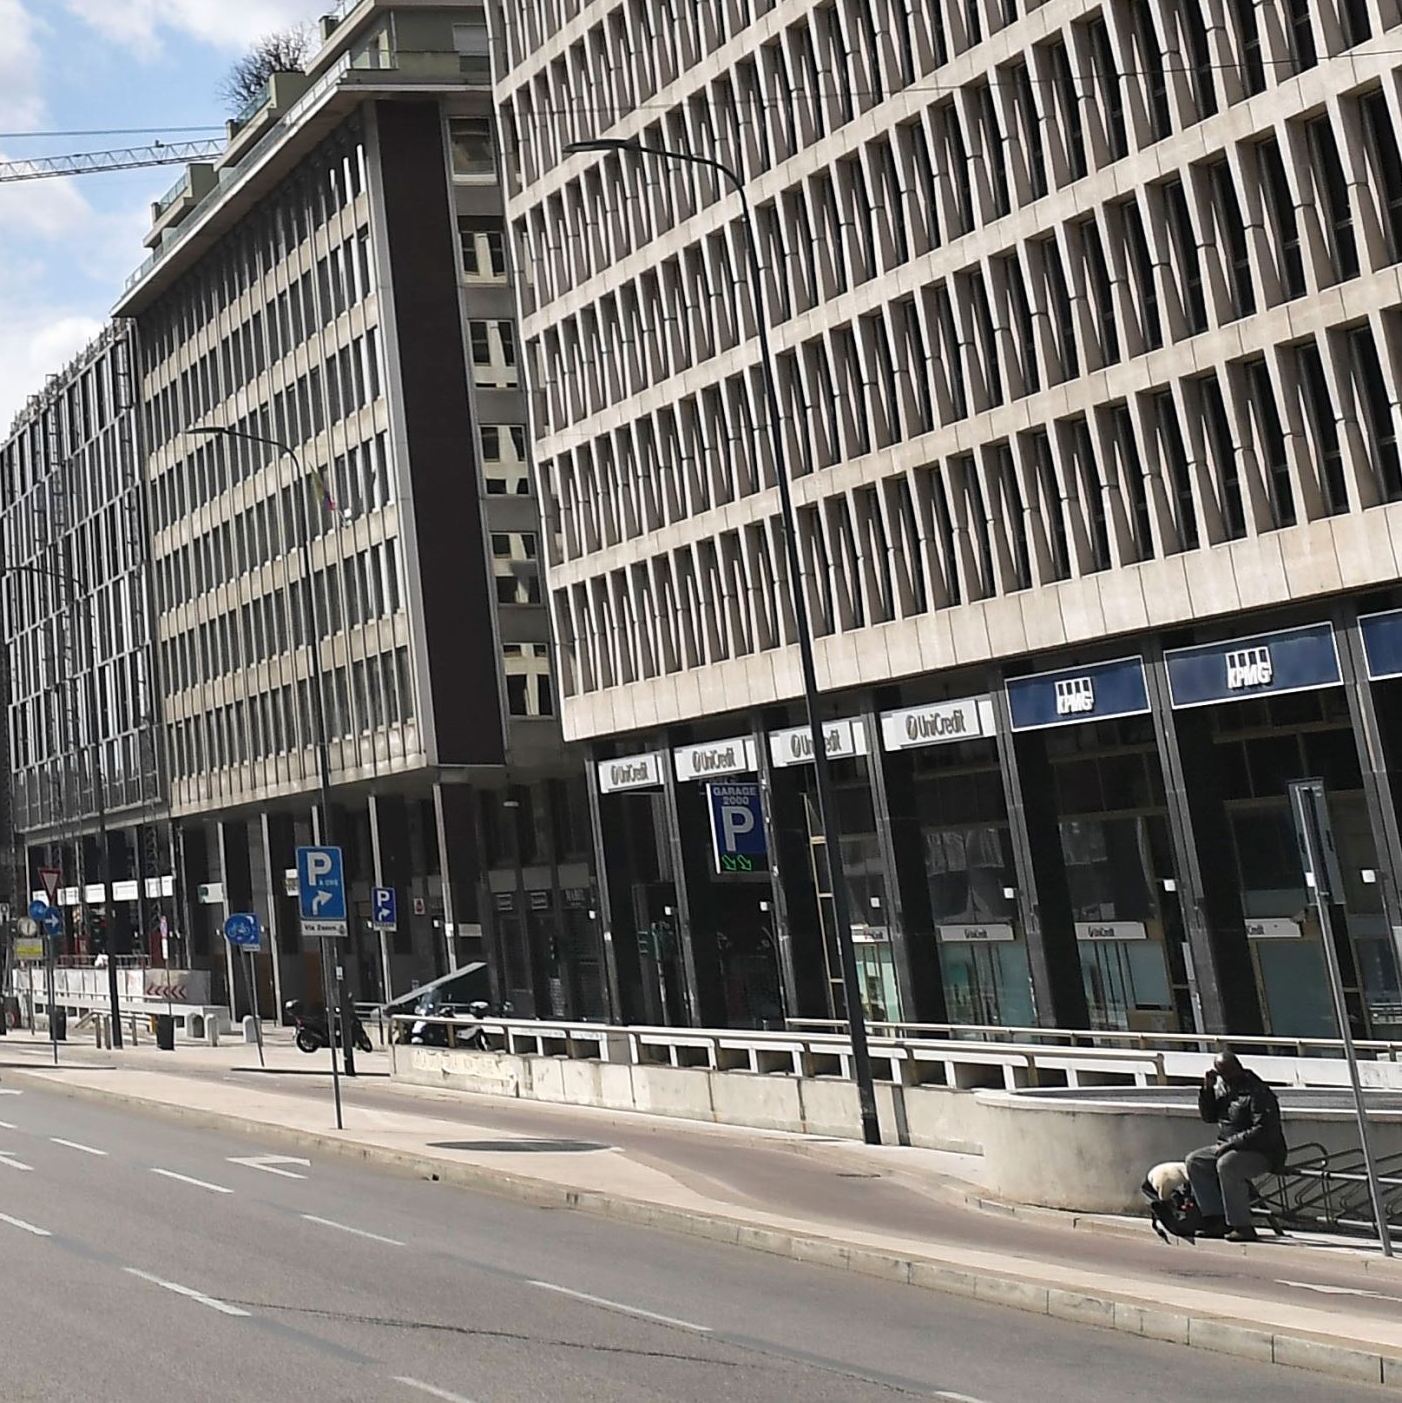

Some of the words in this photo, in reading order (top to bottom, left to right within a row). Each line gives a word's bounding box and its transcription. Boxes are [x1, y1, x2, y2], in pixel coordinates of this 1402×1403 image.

[1225, 658, 1273, 689] KPMG
[1054, 688, 1095, 715] KPMG
[918, 709, 967, 739] UniCredit
[701, 747, 736, 771] UniCredit
[619, 762, 650, 783] UniCredit
[712, 786, 757, 796] GARAGE
[723, 796, 750, 805] 2000
[720, 805, 755, 852] P
[306, 851, 332, 886] P
[376, 890, 390, 907] P
